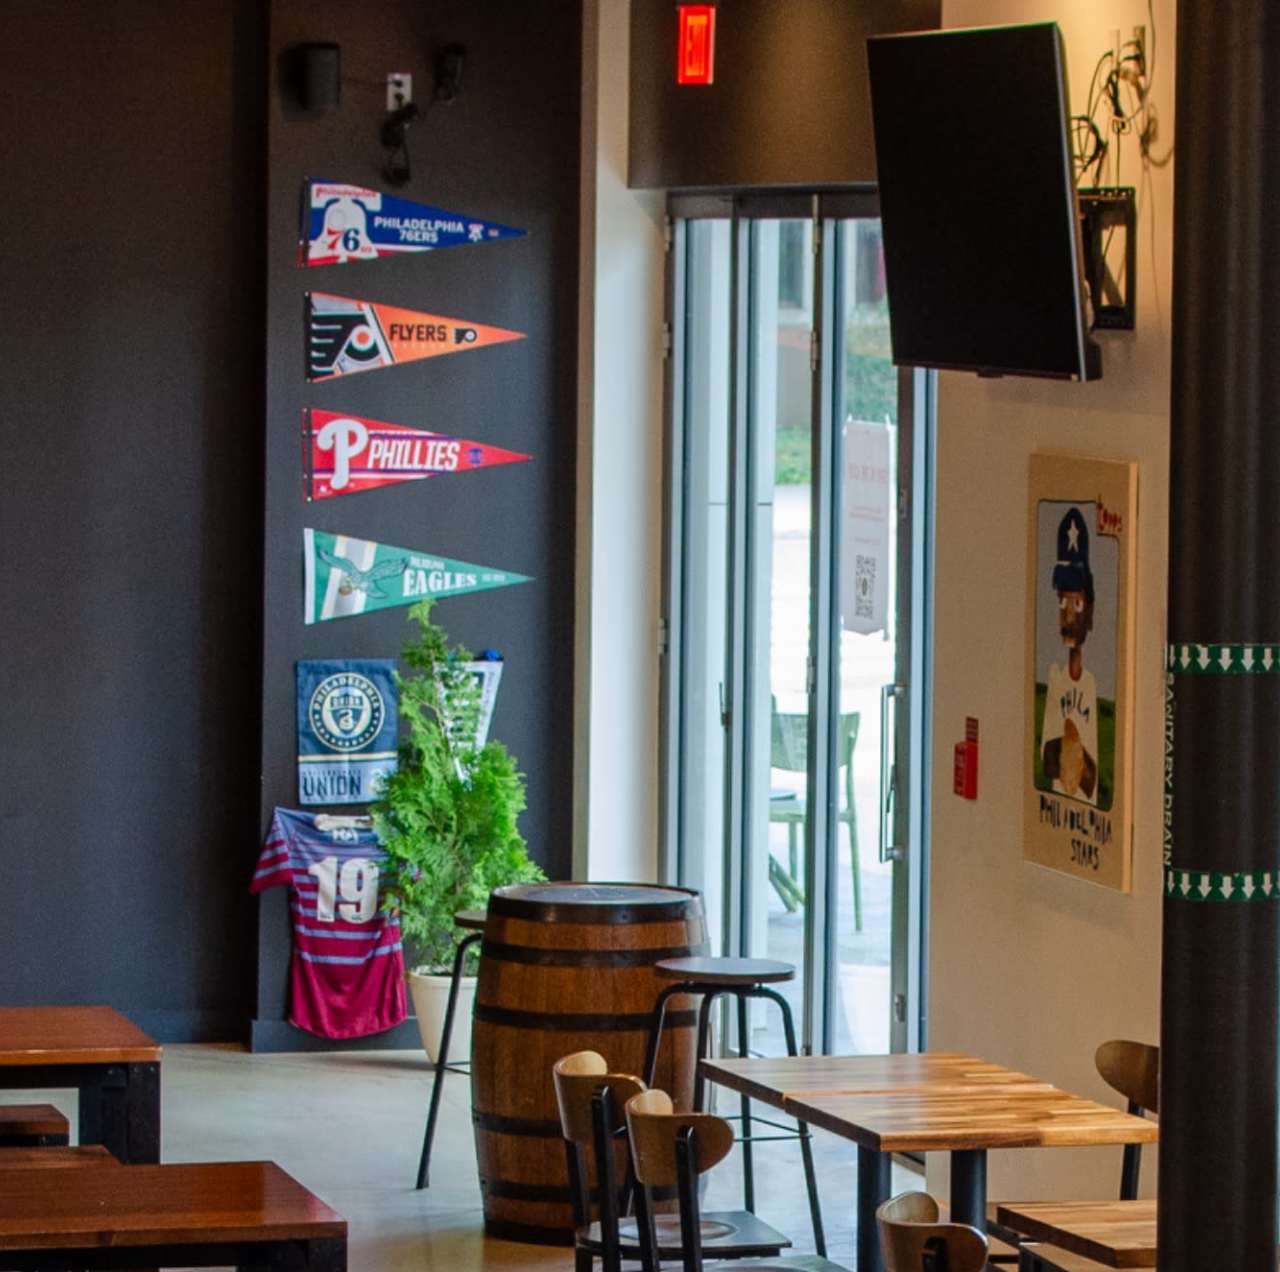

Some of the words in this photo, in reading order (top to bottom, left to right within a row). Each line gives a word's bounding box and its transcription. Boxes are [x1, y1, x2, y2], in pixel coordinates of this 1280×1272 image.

[373, 215, 465, 234] PHILADELPHIA
[398, 229, 439, 244] 76ERS
[326, 228, 360, 252] 76
[388, 323, 448, 342] FLYERS
[368, 439, 461, 471] PHILLIES
[402, 568, 478, 597] EAGLES
[303, 774, 361, 797] UNION
[1040, 793, 1113, 846] PHILADELPHIA
[1164, 794, 1174, 866] DRAIN
[1070, 838, 1100, 871] STARS
[308, 855, 379, 924] 19
